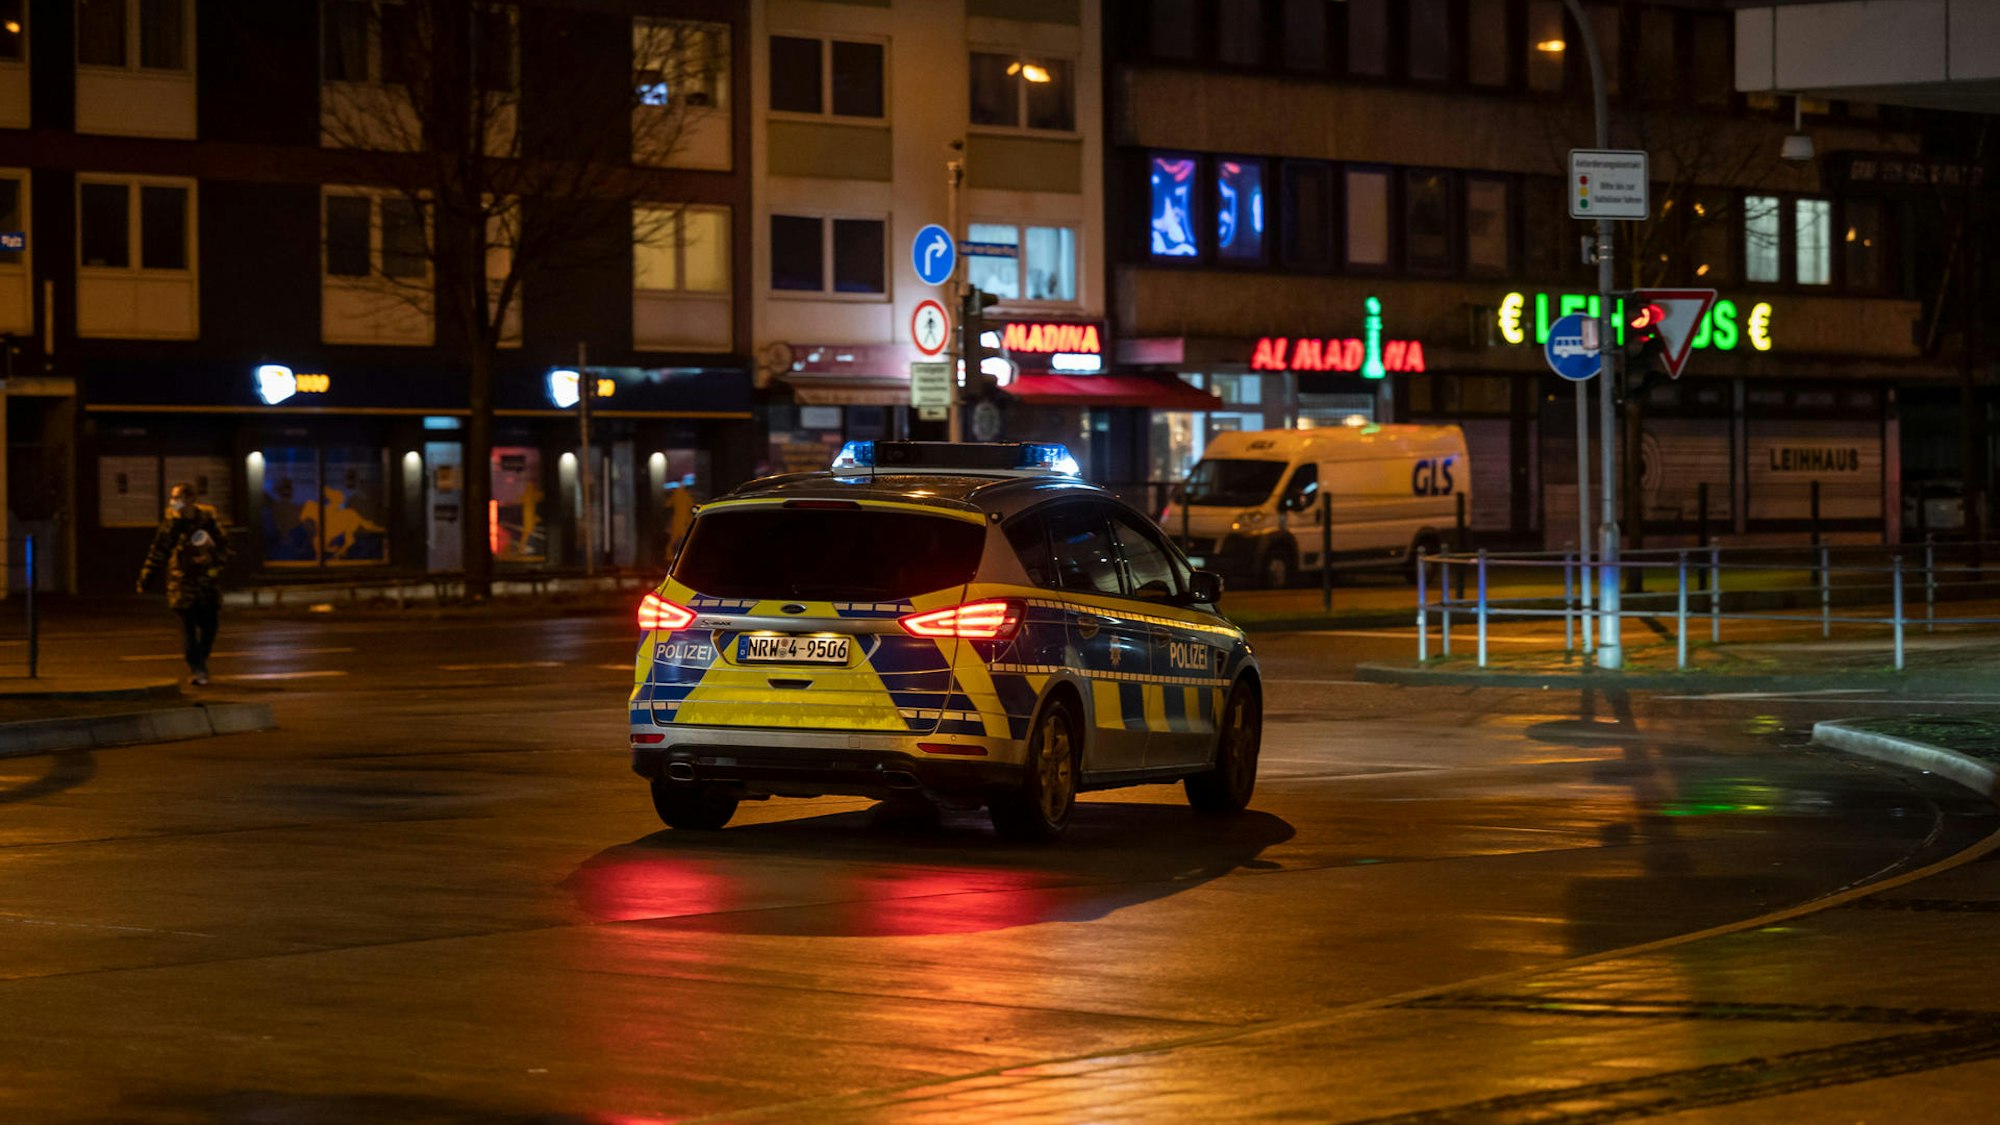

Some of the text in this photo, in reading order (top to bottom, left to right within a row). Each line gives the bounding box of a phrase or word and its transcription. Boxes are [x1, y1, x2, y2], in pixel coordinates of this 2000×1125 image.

[1002, 322, 1101, 353] MADINA
[1251, 336, 1288, 371] AL
[1769, 448, 1859, 472] LEIHHAUS
[1412, 459, 1454, 496] GLS
[656, 643, 712, 661] POLIZEI
[748, 638, 780, 657] NRW
[788, 639, 847, 659] 4-9506
[1170, 641, 1208, 670] POLIZEI
